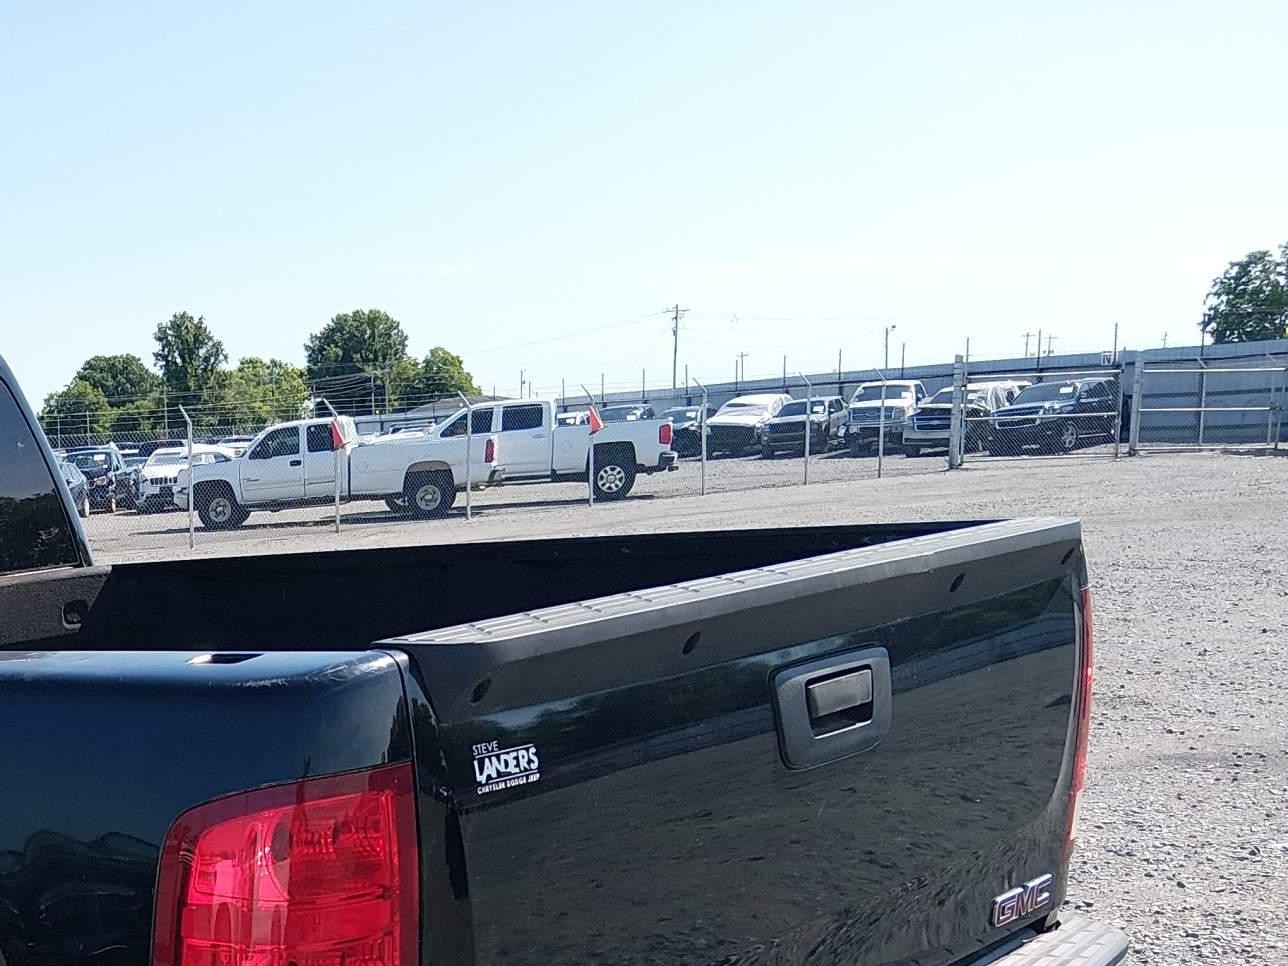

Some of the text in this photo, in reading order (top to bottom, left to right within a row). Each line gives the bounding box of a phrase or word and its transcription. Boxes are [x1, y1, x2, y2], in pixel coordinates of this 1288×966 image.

[472, 740, 499, 755] STEVE
[473, 746, 539, 784] LANDERS
[477, 773, 540, 795] CHRYSLER DODGE JEEP
[993, 873, 1053, 928] GMC
